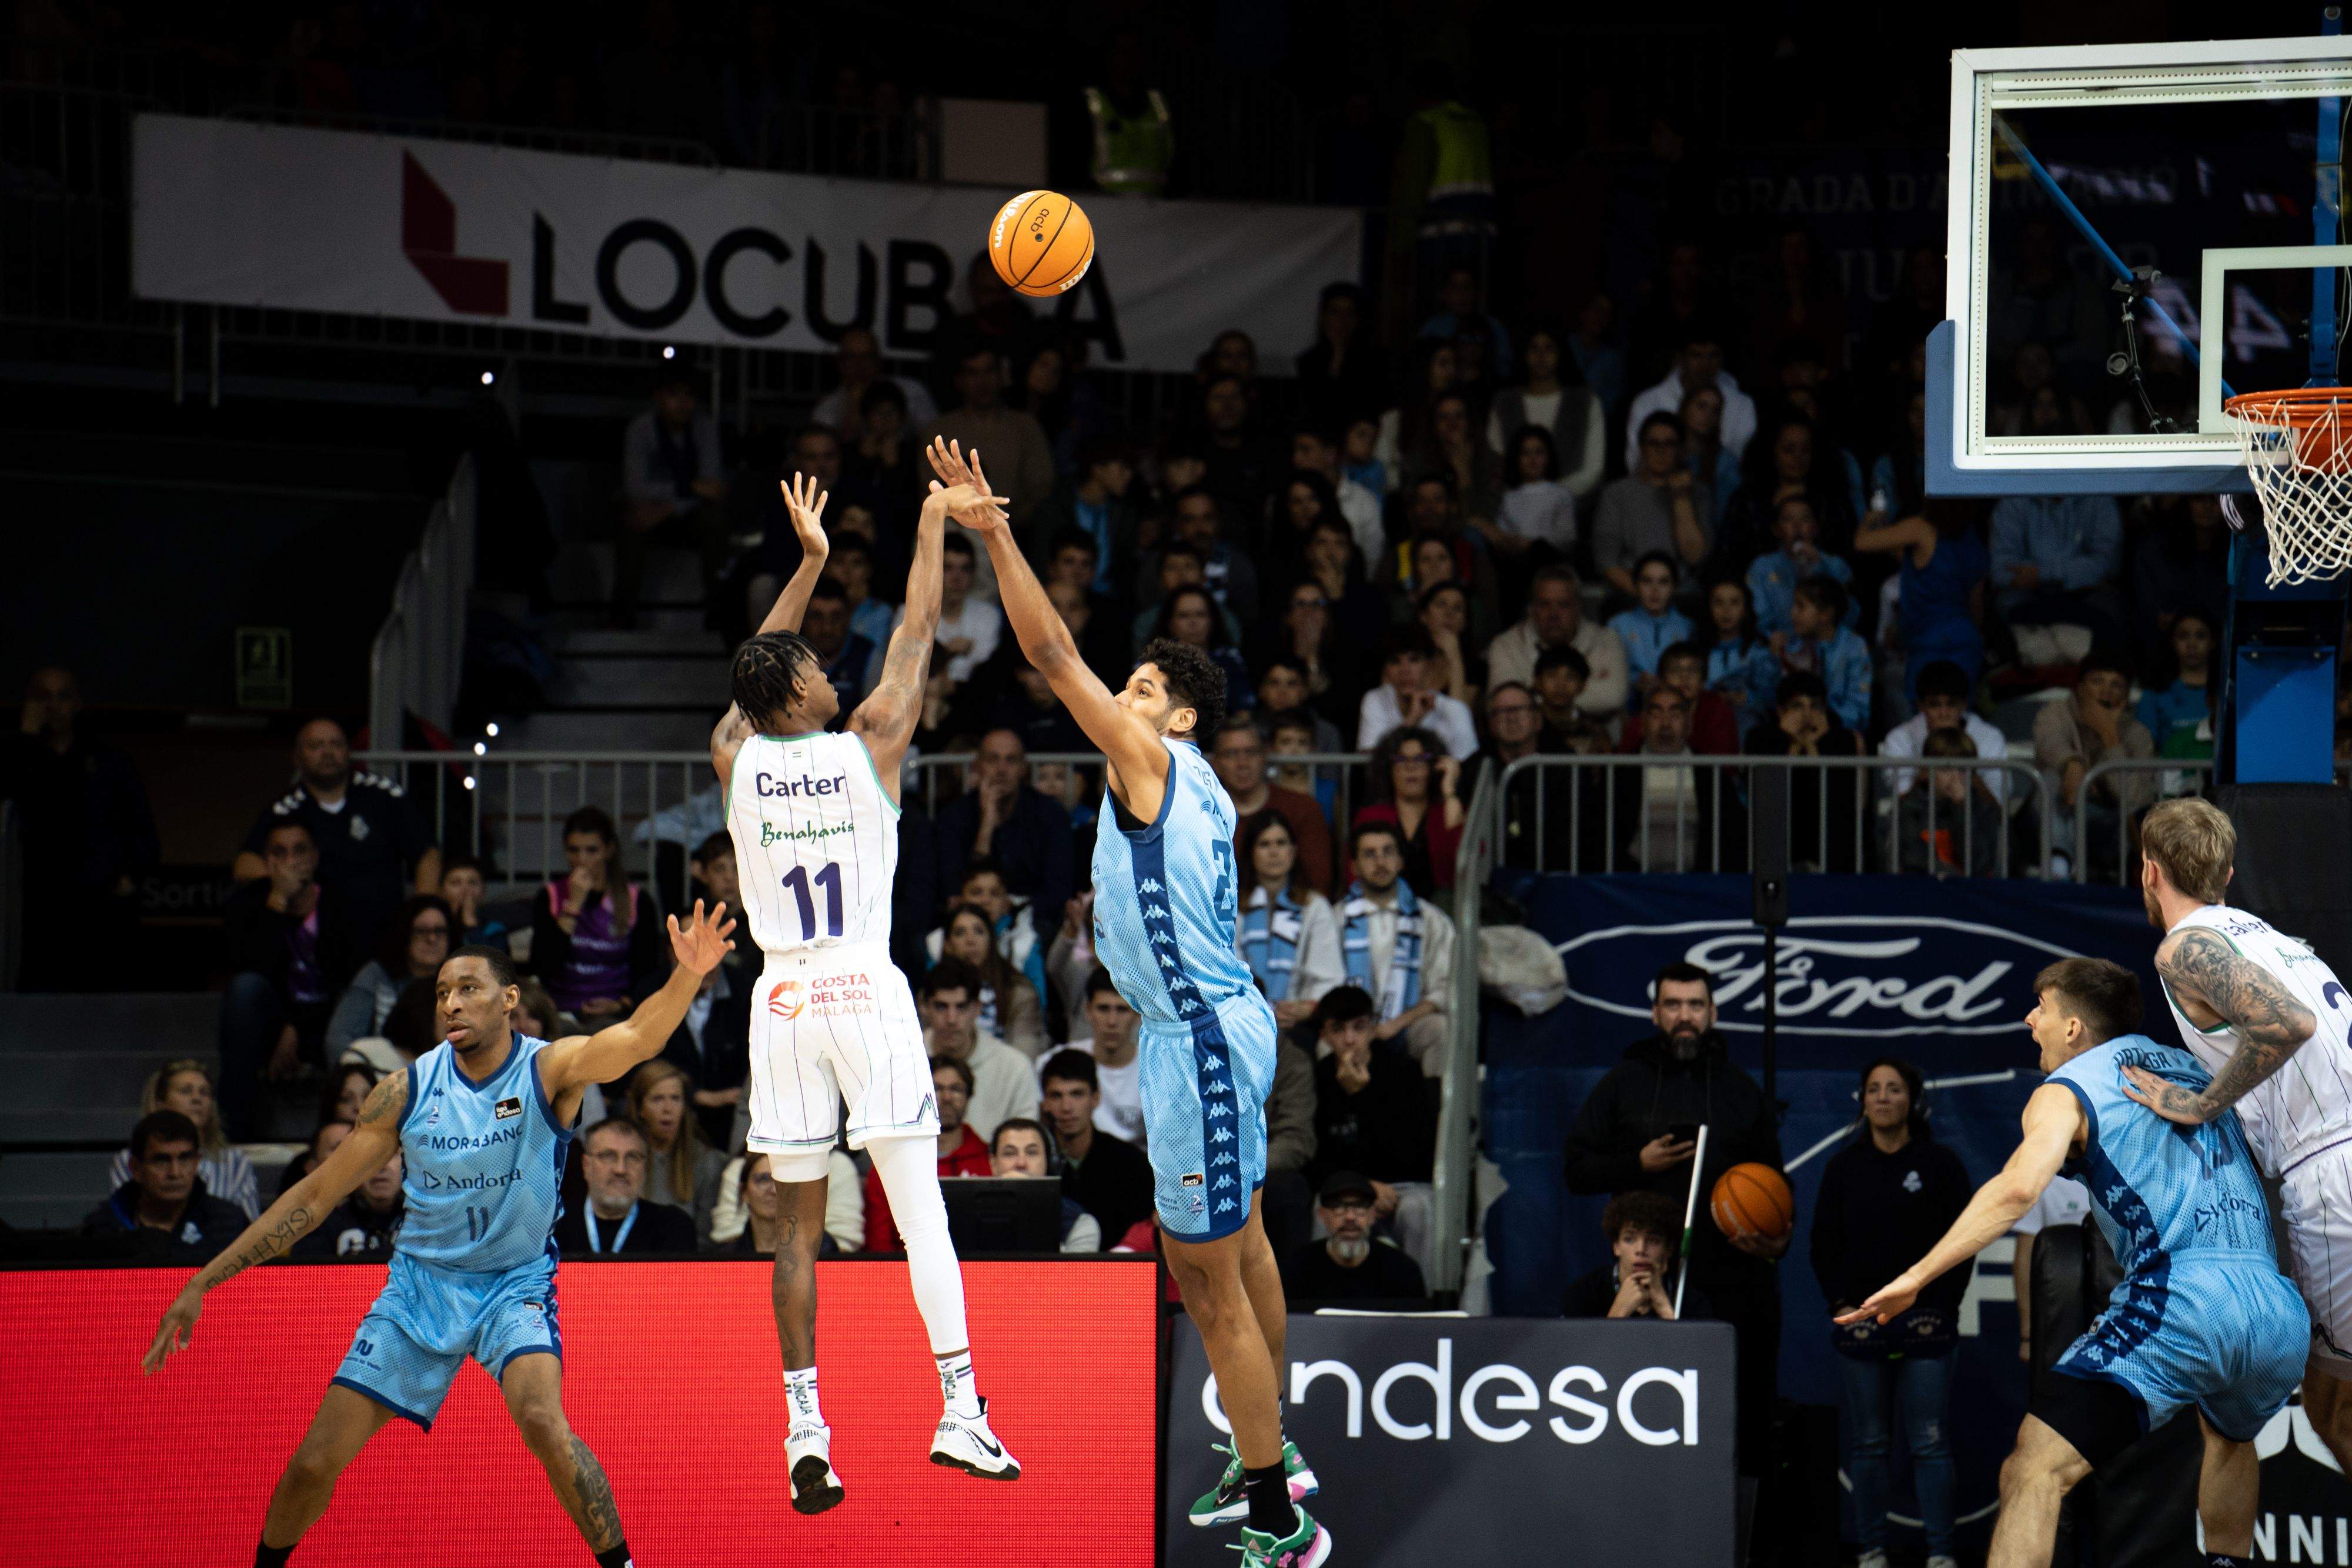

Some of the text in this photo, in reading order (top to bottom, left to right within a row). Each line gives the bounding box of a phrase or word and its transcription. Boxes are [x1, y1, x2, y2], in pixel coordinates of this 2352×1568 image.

[1030, 208, 1050, 232] acb
[534, 210, 1124, 360] LOCUBA
[756, 772, 846, 797] Carter
[142, 876, 235, 908] Sorti
[781, 862, 844, 941] 11
[812, 974, 870, 989] COSTA
[1646, 934, 2014, 1022] Ford
[811, 989, 872, 1004] DEL SOL
[1184, 1178, 1199, 1186] acb
[466, 1206, 489, 1242] 11
[2195, 1507, 2350, 1567] NNI
